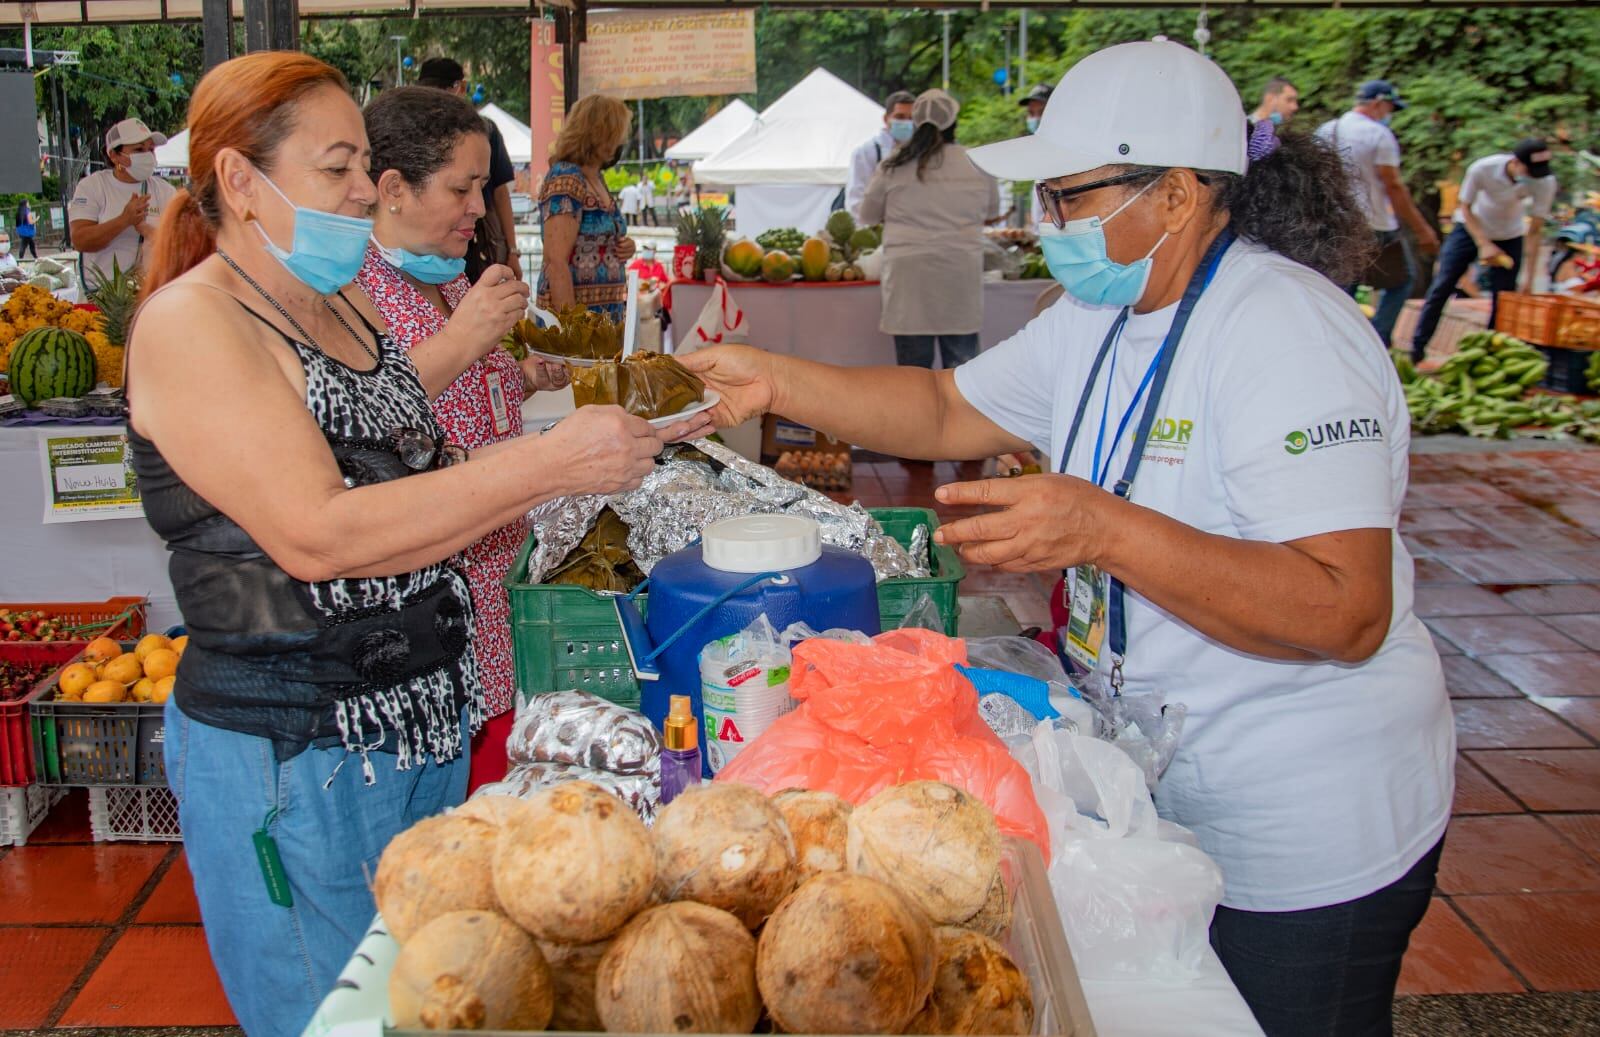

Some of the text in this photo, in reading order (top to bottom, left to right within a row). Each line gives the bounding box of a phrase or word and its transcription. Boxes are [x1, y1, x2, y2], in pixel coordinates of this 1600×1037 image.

[1307, 418, 1383, 446] UMATA
[85, 440, 123, 448] CAMPESINO
[52, 447, 119, 456] INTERINSTITUCIONAL
